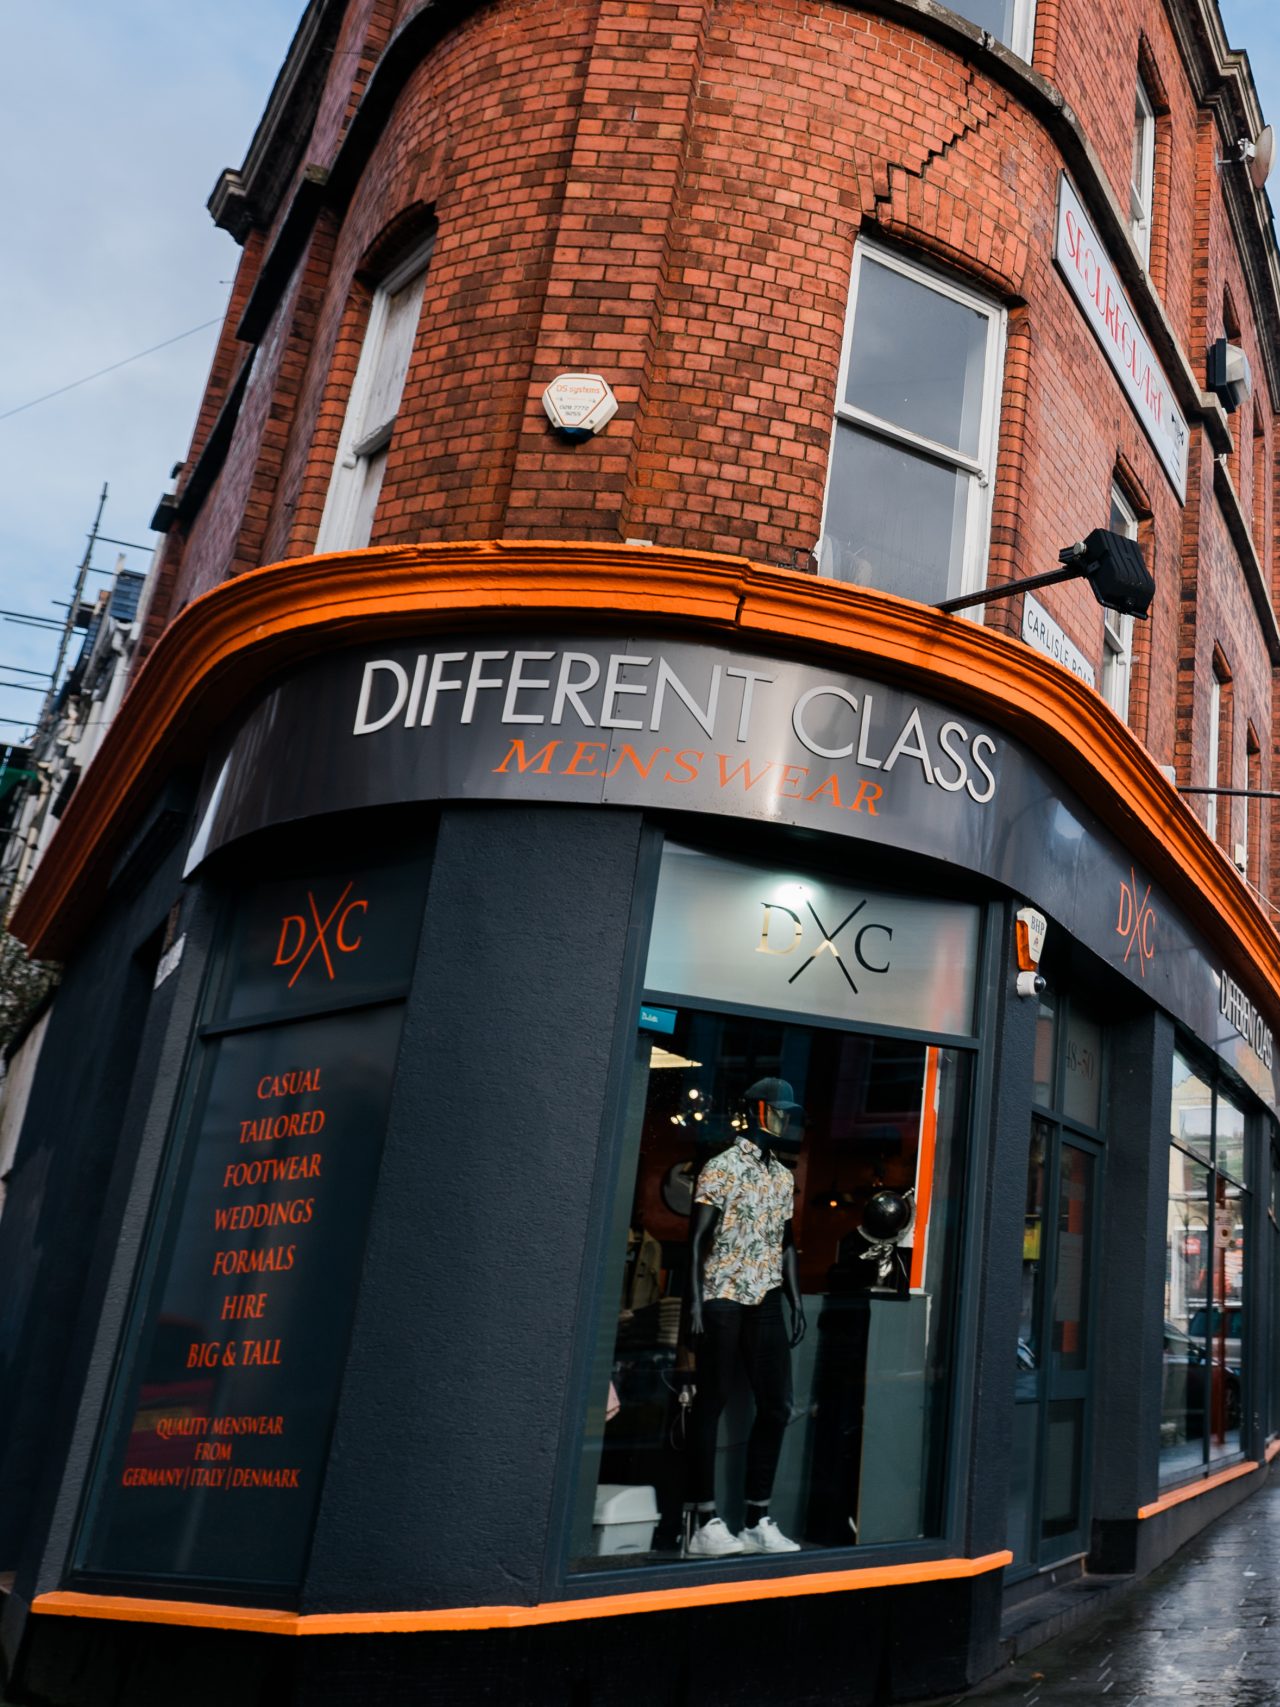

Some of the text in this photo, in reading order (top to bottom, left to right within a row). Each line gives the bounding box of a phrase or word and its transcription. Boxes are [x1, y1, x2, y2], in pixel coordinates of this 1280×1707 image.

[1027, 610, 1069, 668] CARLISLE
[352, 650, 997, 805] DIFFERENT CLASS
[491, 738, 885, 818] MENSWEAR
[272, 881, 369, 989] DXC
[1031, 915, 1045, 936] BHP
[1115, 866, 1157, 978] DXC
[754, 898, 895, 996] DXC
[257, 1068, 321, 1100] CASUAL
[240, 1109, 325, 1144] TAILORED
[223, 1153, 321, 1188] FOOTWEAR
[214, 1198, 313, 1232] WEDDINGS
[212, 1244, 295, 1276] FORMALS
[220, 1293, 269, 1321] HIRE
[186, 1339, 282, 1369] BIG & TALL
[156, 1415, 284, 1440] QUALITY MENSWEAR
[194, 1442, 233, 1461] FROM
[122, 1467, 300, 1488] GERMANY ITALY DENMARK
